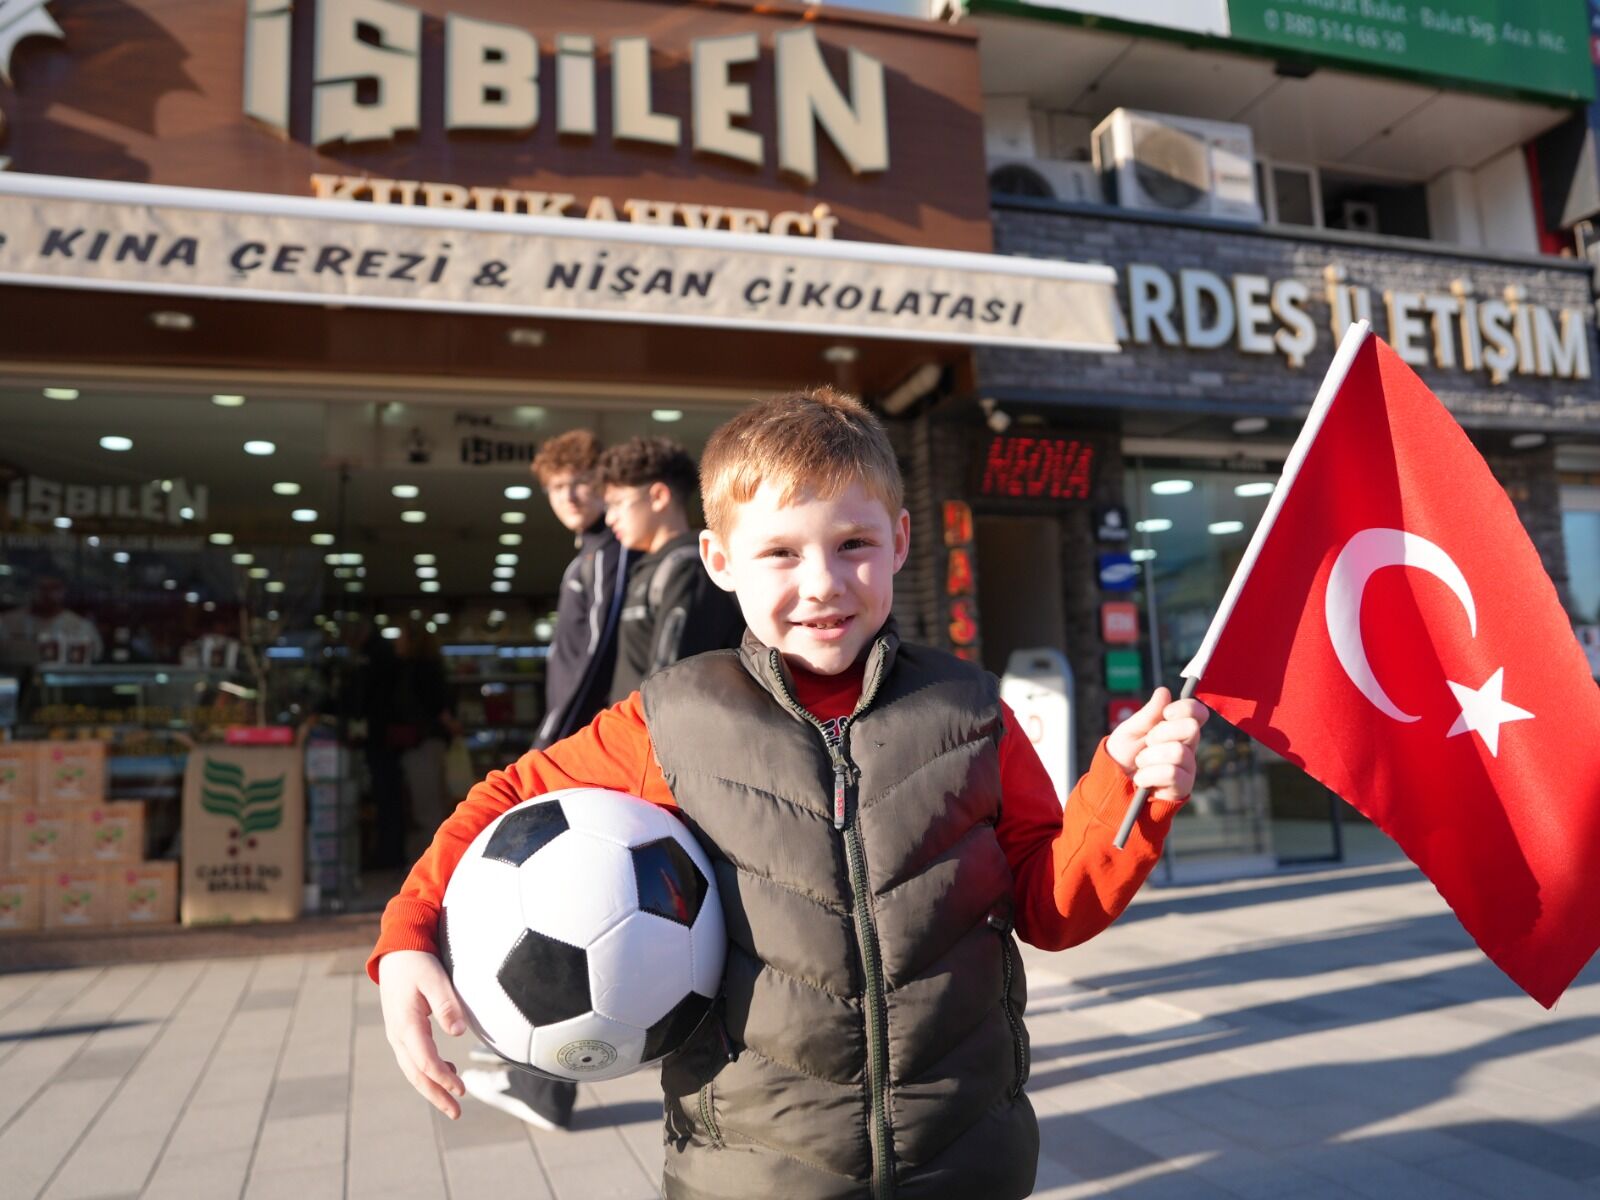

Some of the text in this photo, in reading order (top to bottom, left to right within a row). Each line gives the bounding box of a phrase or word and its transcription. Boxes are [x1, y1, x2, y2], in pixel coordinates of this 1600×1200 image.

[39, 228, 1027, 328] KINA ÇEREZİ & NİŞAN ÇİKOLATASI
